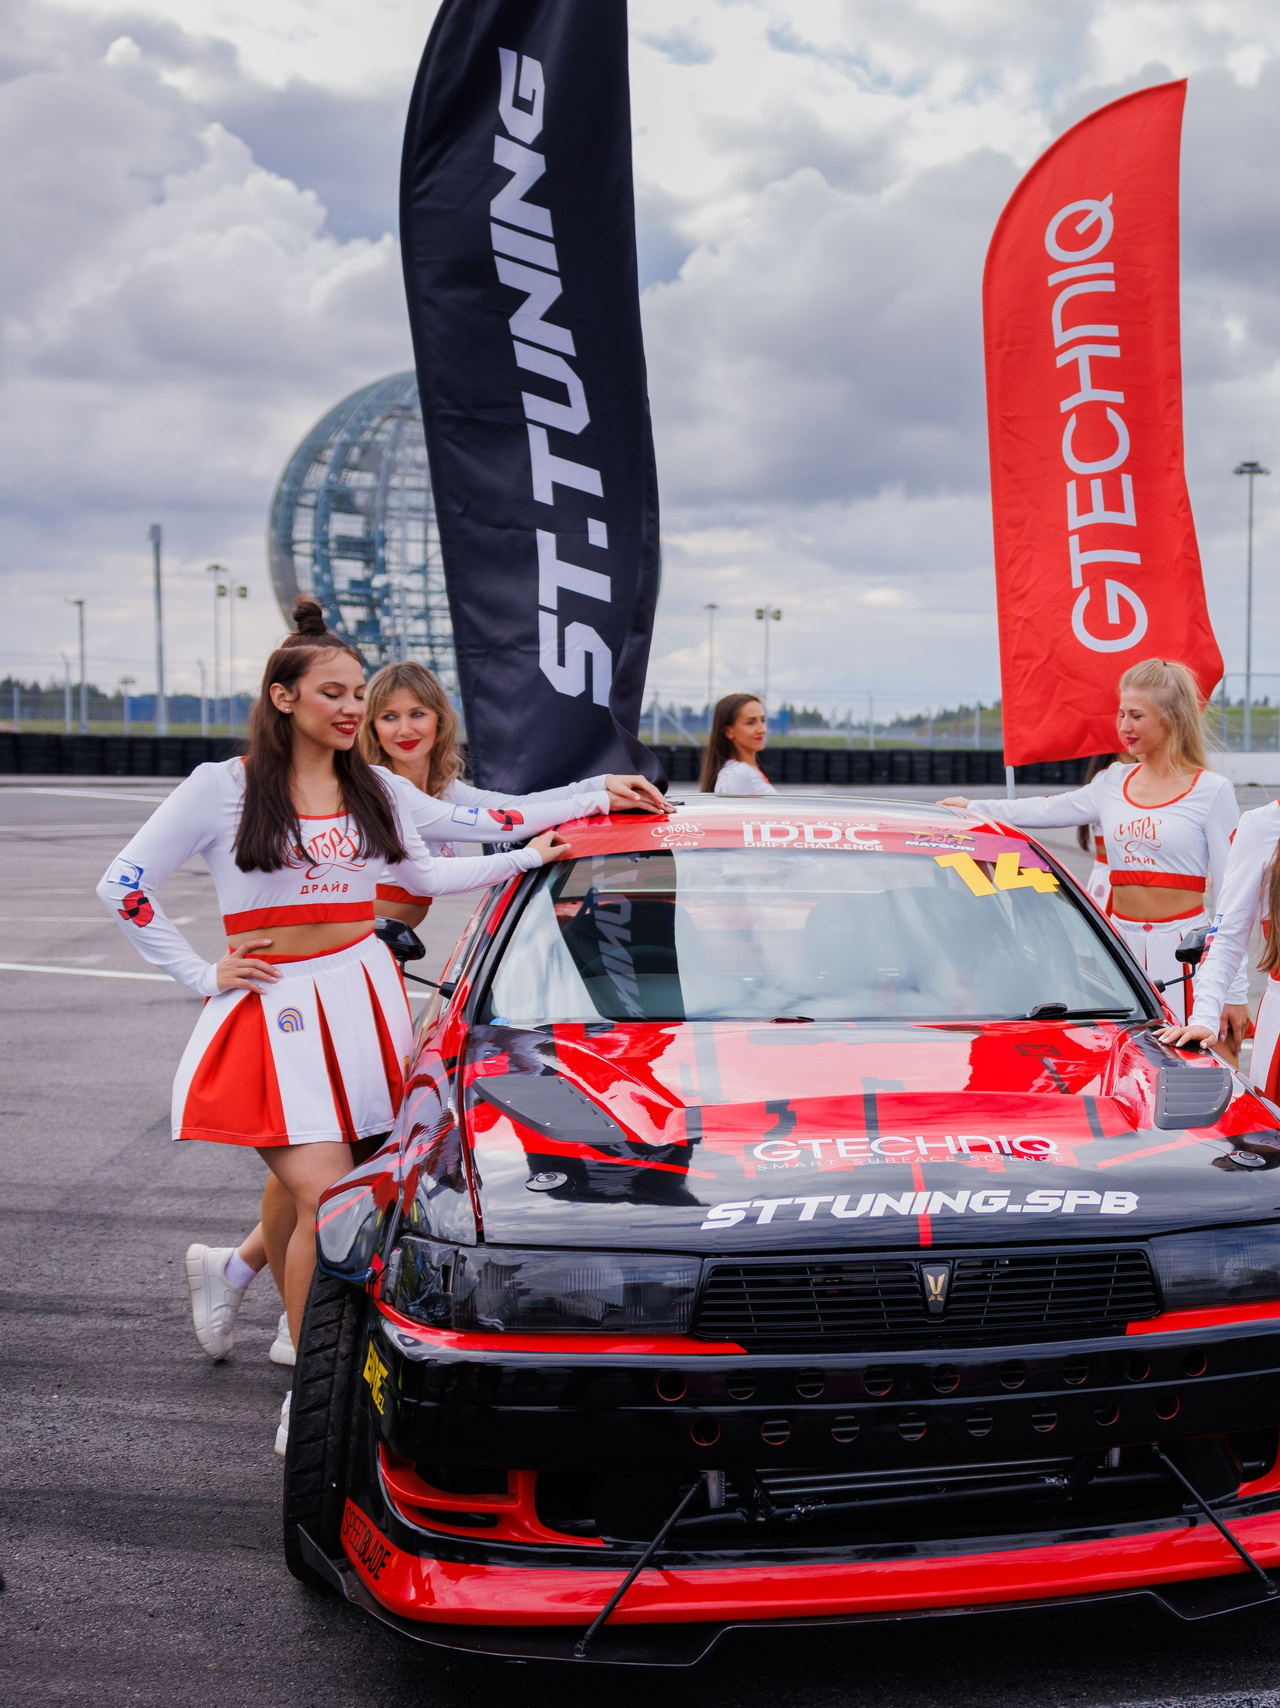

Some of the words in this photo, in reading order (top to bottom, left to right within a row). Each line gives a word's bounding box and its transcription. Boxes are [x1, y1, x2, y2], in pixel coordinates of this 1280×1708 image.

[490, 47, 612, 707] ST.TUNING
[1045, 192, 1148, 654] GTECHNIQ
[742, 823, 882, 845] IDDC
[793, 841, 885, 851] CHALLENGE
[933, 851, 1061, 897] 14
[1124, 855, 1157, 866] ДРАЙВ
[300, 881, 349, 895] ДРАЙВ
[752, 1135, 1061, 1162] GTECHNIQ
[756, 1159, 837, 1171] SMART
[853, 1155, 956, 1166] SURFACE
[970, 1154, 1065, 1164] SCIENCE
[700, 1189, 1140, 1230] STTUNING.SPB
[342, 1506, 391, 1581] SPEEDBLADE
